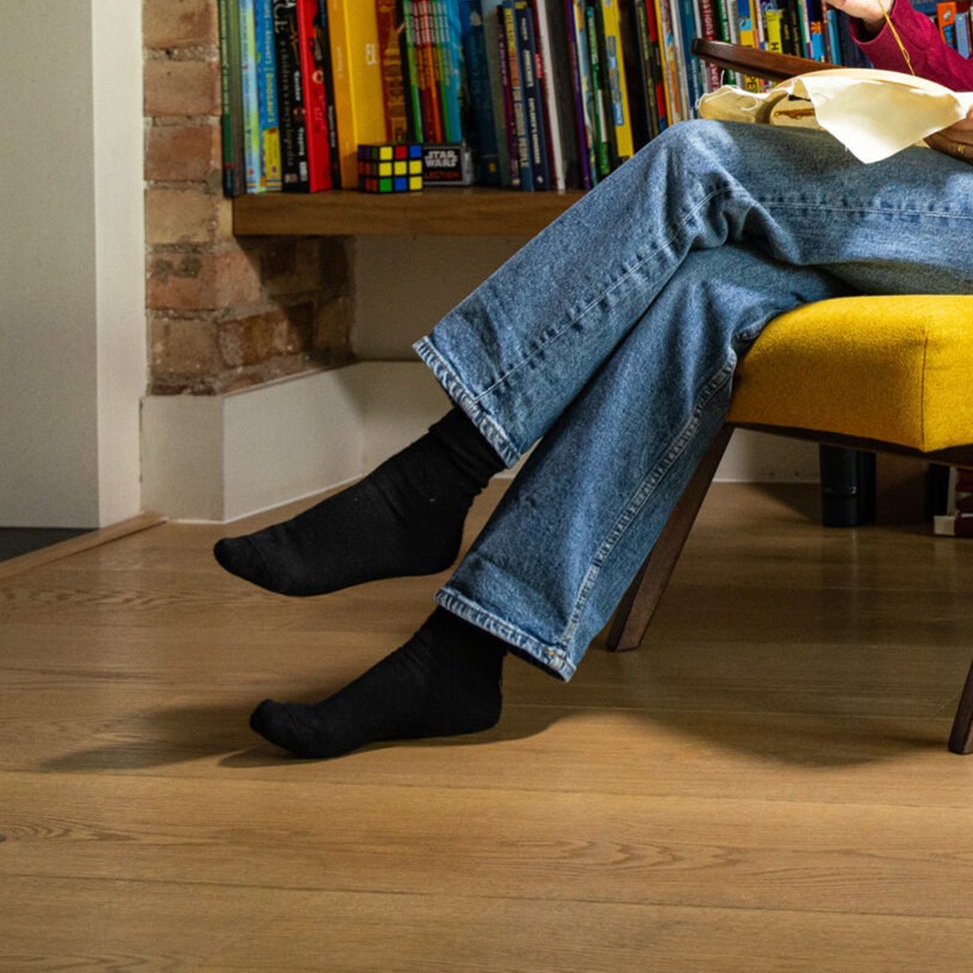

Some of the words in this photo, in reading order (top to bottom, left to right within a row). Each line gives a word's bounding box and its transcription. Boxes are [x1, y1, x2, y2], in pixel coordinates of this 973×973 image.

[425, 150, 457, 159] STAR
[518, 137, 529, 167] PEOPLE
[425, 157, 457, 168] WARS
